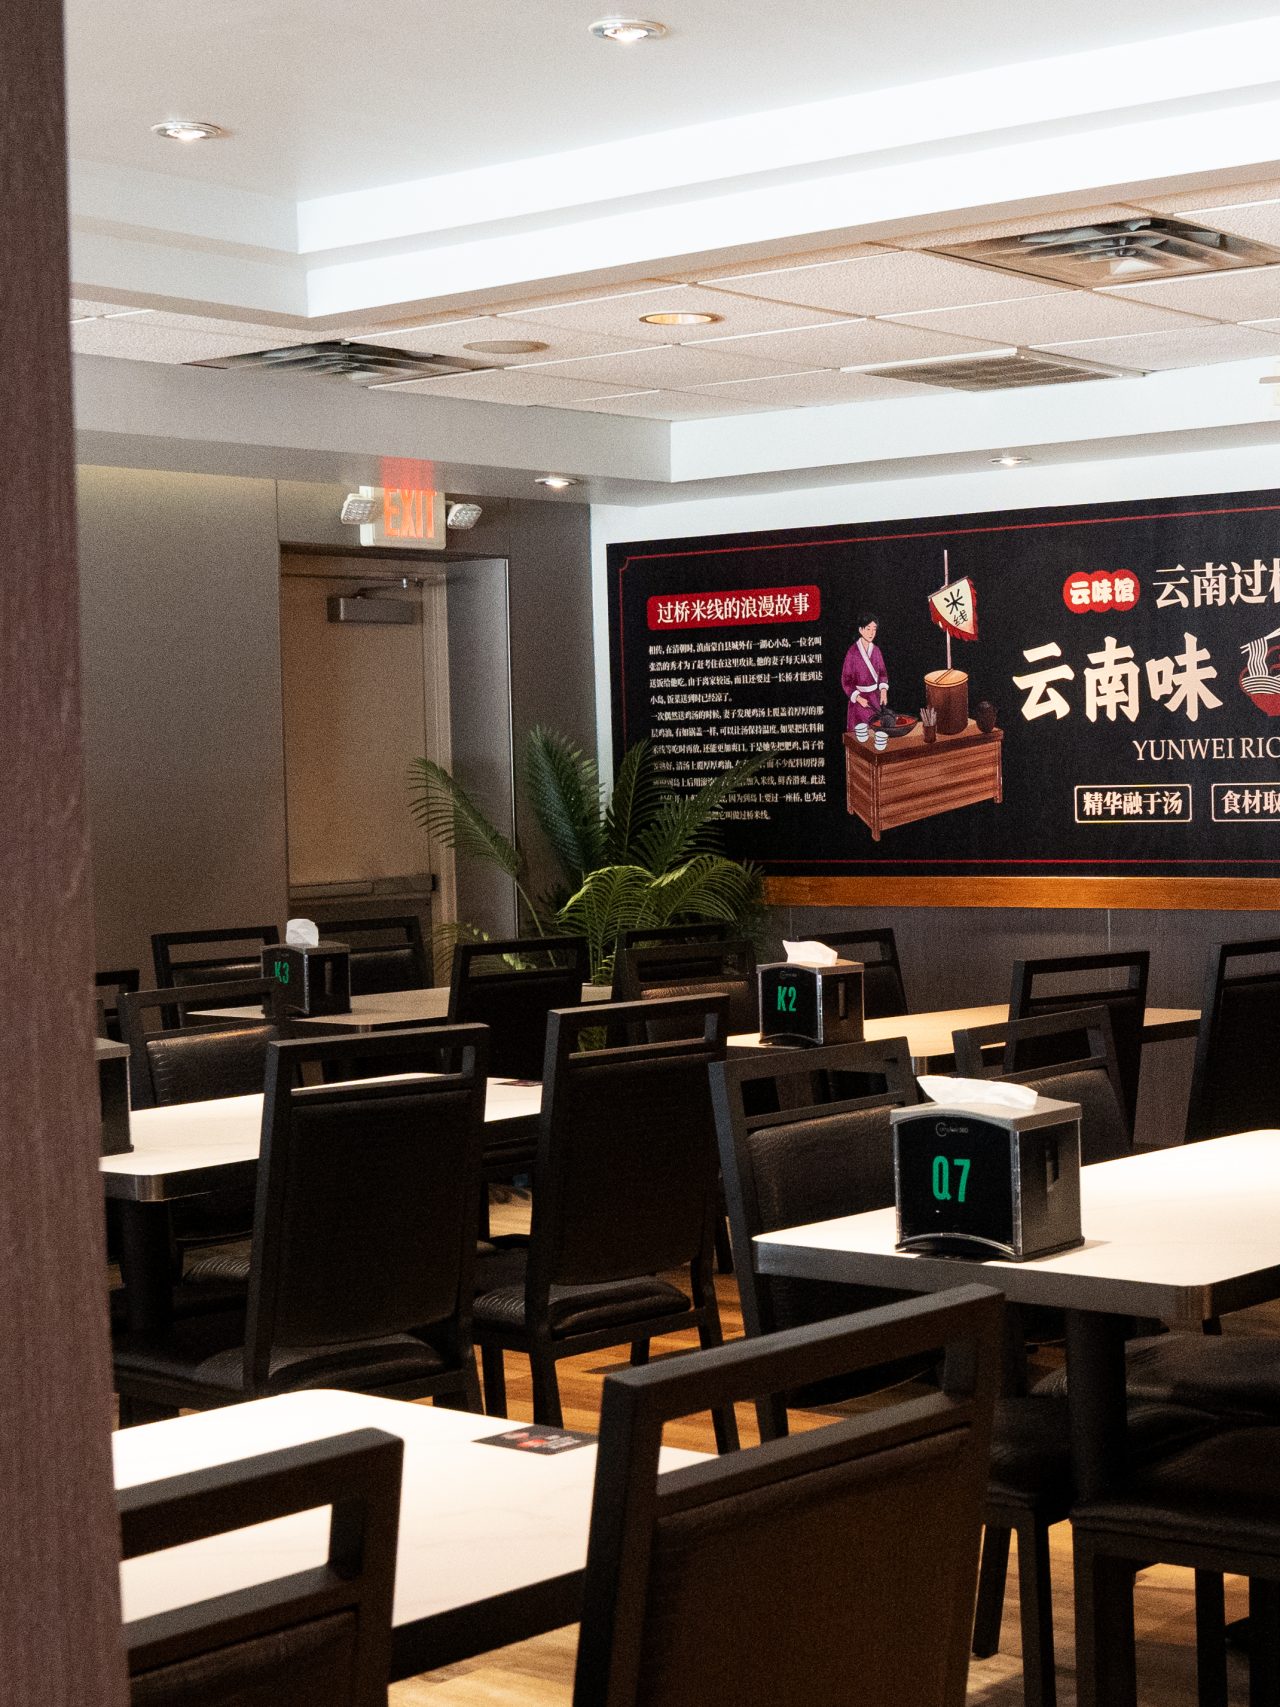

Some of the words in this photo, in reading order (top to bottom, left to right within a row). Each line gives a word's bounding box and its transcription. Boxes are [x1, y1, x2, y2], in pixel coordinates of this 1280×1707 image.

[383, 489, 437, 539] EXIT
[1070, 578, 1134, 604] 云味馆
[658, 593, 809, 623] 过桥米线的浪漫故事
[943, 588, 968, 626] 米线
[1013, 632, 1223, 722] 云南味
[1133, 738, 1234, 760] YUNWEI
[1084, 791, 1182, 815] 精华融于汤
[275, 961, 289, 985] K3
[777, 986, 796, 1012] K2
[932, 1156, 971, 1202] Q7
